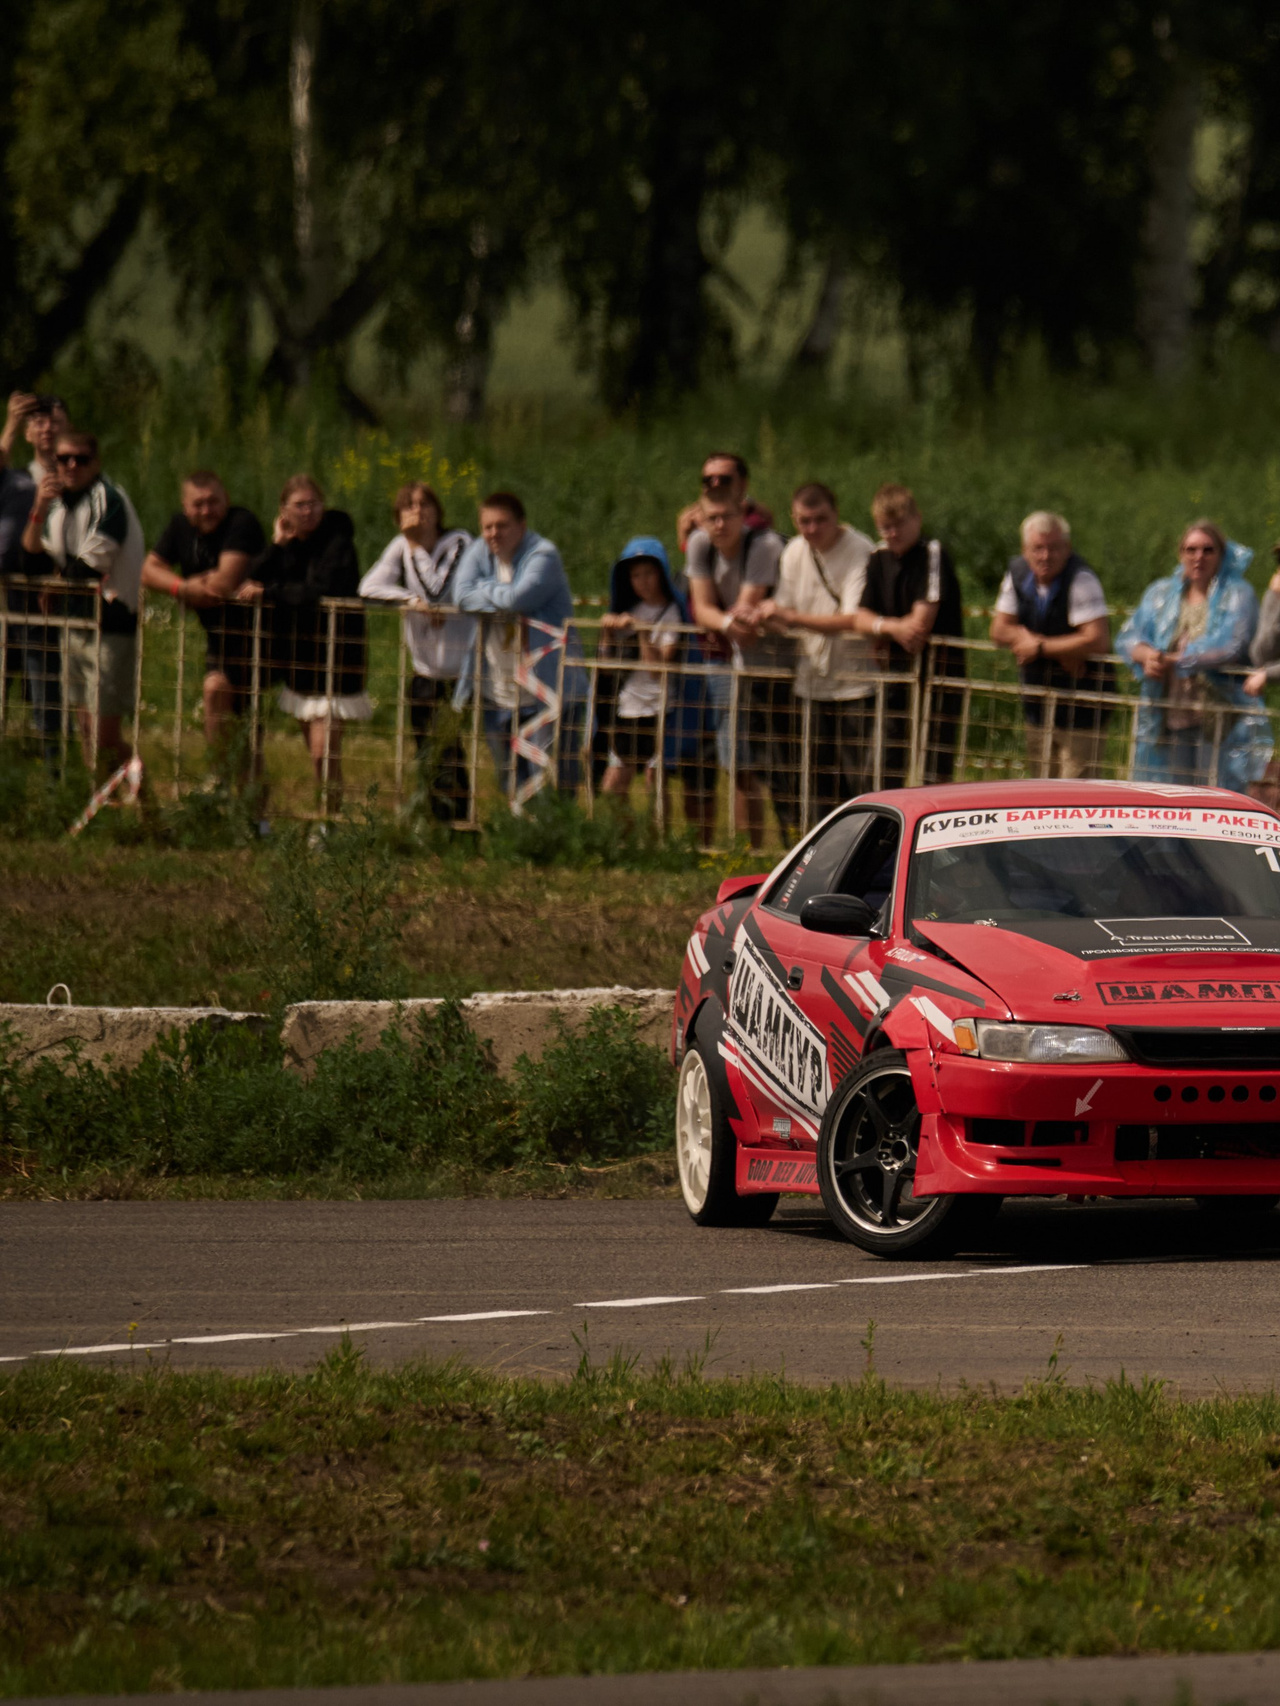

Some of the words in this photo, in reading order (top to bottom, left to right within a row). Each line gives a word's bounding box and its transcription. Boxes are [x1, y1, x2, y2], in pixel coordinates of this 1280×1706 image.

[922, 813, 999, 834] КУБОК
[1006, 808, 1192, 822] БАРНАУЛЬСКОЙ
[1221, 829, 1261, 839] СЕЗОН
[1081, 947, 1163, 955] ПРОИЗВОДСТВО
[731, 957, 823, 1107] ШАМПУР
